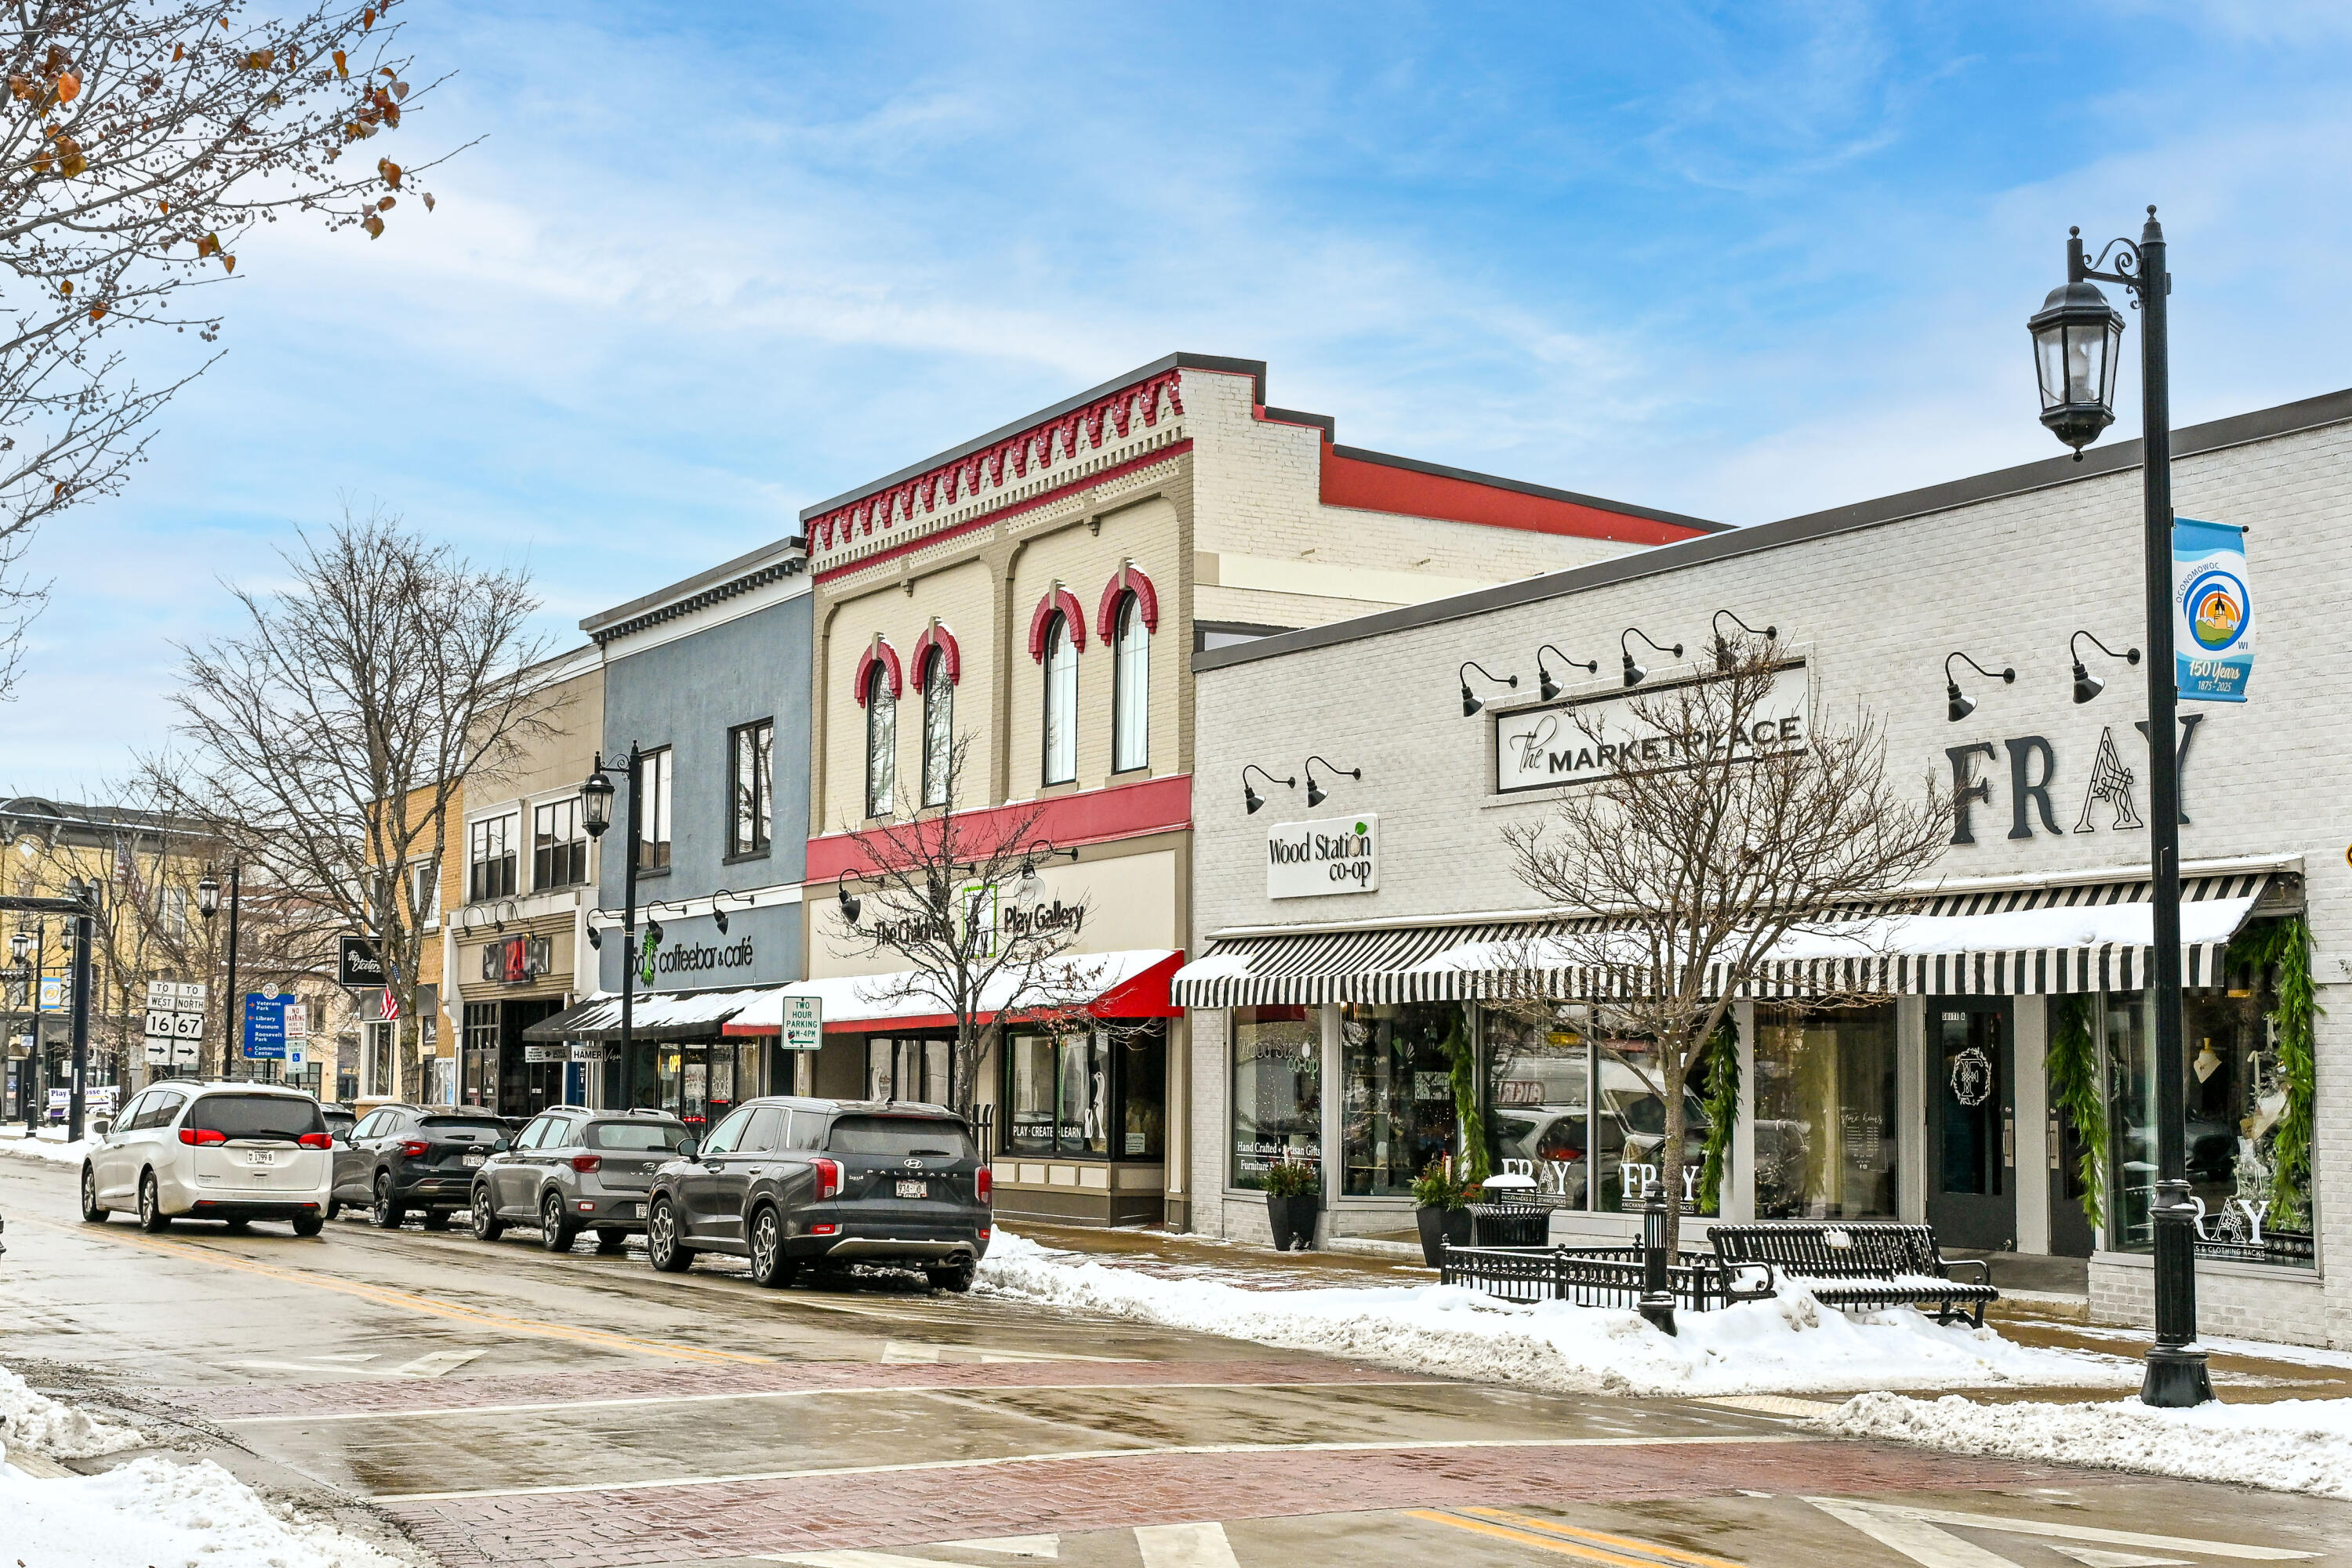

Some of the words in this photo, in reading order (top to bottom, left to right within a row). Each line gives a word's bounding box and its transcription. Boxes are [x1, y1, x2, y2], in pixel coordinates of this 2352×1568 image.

[2176, 562, 2220, 603] OCONOMOWOC
[2238, 641, 2249, 650] WI
[2190, 659, 2211, 677] 150
[2212, 662, 2241, 683] Years
[2198, 681, 2212, 690] 1875
[2216, 681, 2232, 691] 2025
[1510, 715, 1558, 773] The
[1549, 716, 1802, 774] MARKETPLACE
[1269, 831, 1311, 865] Wood
[1315, 831, 1371, 861] Station
[1329, 861, 1371, 887] co-op
[1004, 906, 1033, 937] Play
[1034, 900, 1084, 934] Gallery
[874, 920, 897, 946] The
[347, 949, 360, 961] the
[659, 942, 717, 974] coffeebar
[718, 951, 724, 967] &
[724, 935, 753, 968] café
[156, 983, 169, 993] TO
[187, 985, 198, 994] TO
[151, 996, 172, 1007] WEST
[177, 1000, 204, 1009] NORTH
[151, 1016, 169, 1032] 16
[178, 1018, 200, 1034] 67
[574, 1050, 602, 1059] HAMER
[1239, 1035, 1272, 1058] Wood
[1287, 1057, 1319, 1080] co-op
[1013, 1126, 1027, 1137] PLAY
[1031, 1126, 1053, 1138] CREATE
[1061, 1126, 1081, 1138] LEARN
[1237, 1141, 1254, 1152] Hand
[1254, 1142, 1277, 1153] Crafted
[1283, 1144, 1305, 1156] rtisan
[1305, 1142, 1321, 1156] Gifts
[1240, 1159, 1269, 1171] Furniture
[866, 1169, 958, 1178] PALISADE
[1501, 1158, 1571, 1195] FRAY
[1621, 1163, 1700, 1201] FRY
[2190, 1196, 2270, 1244] RAY
[2208, 1246, 2241, 1255] CLOTHING
[2243, 1247, 2265, 1258] RACKS
